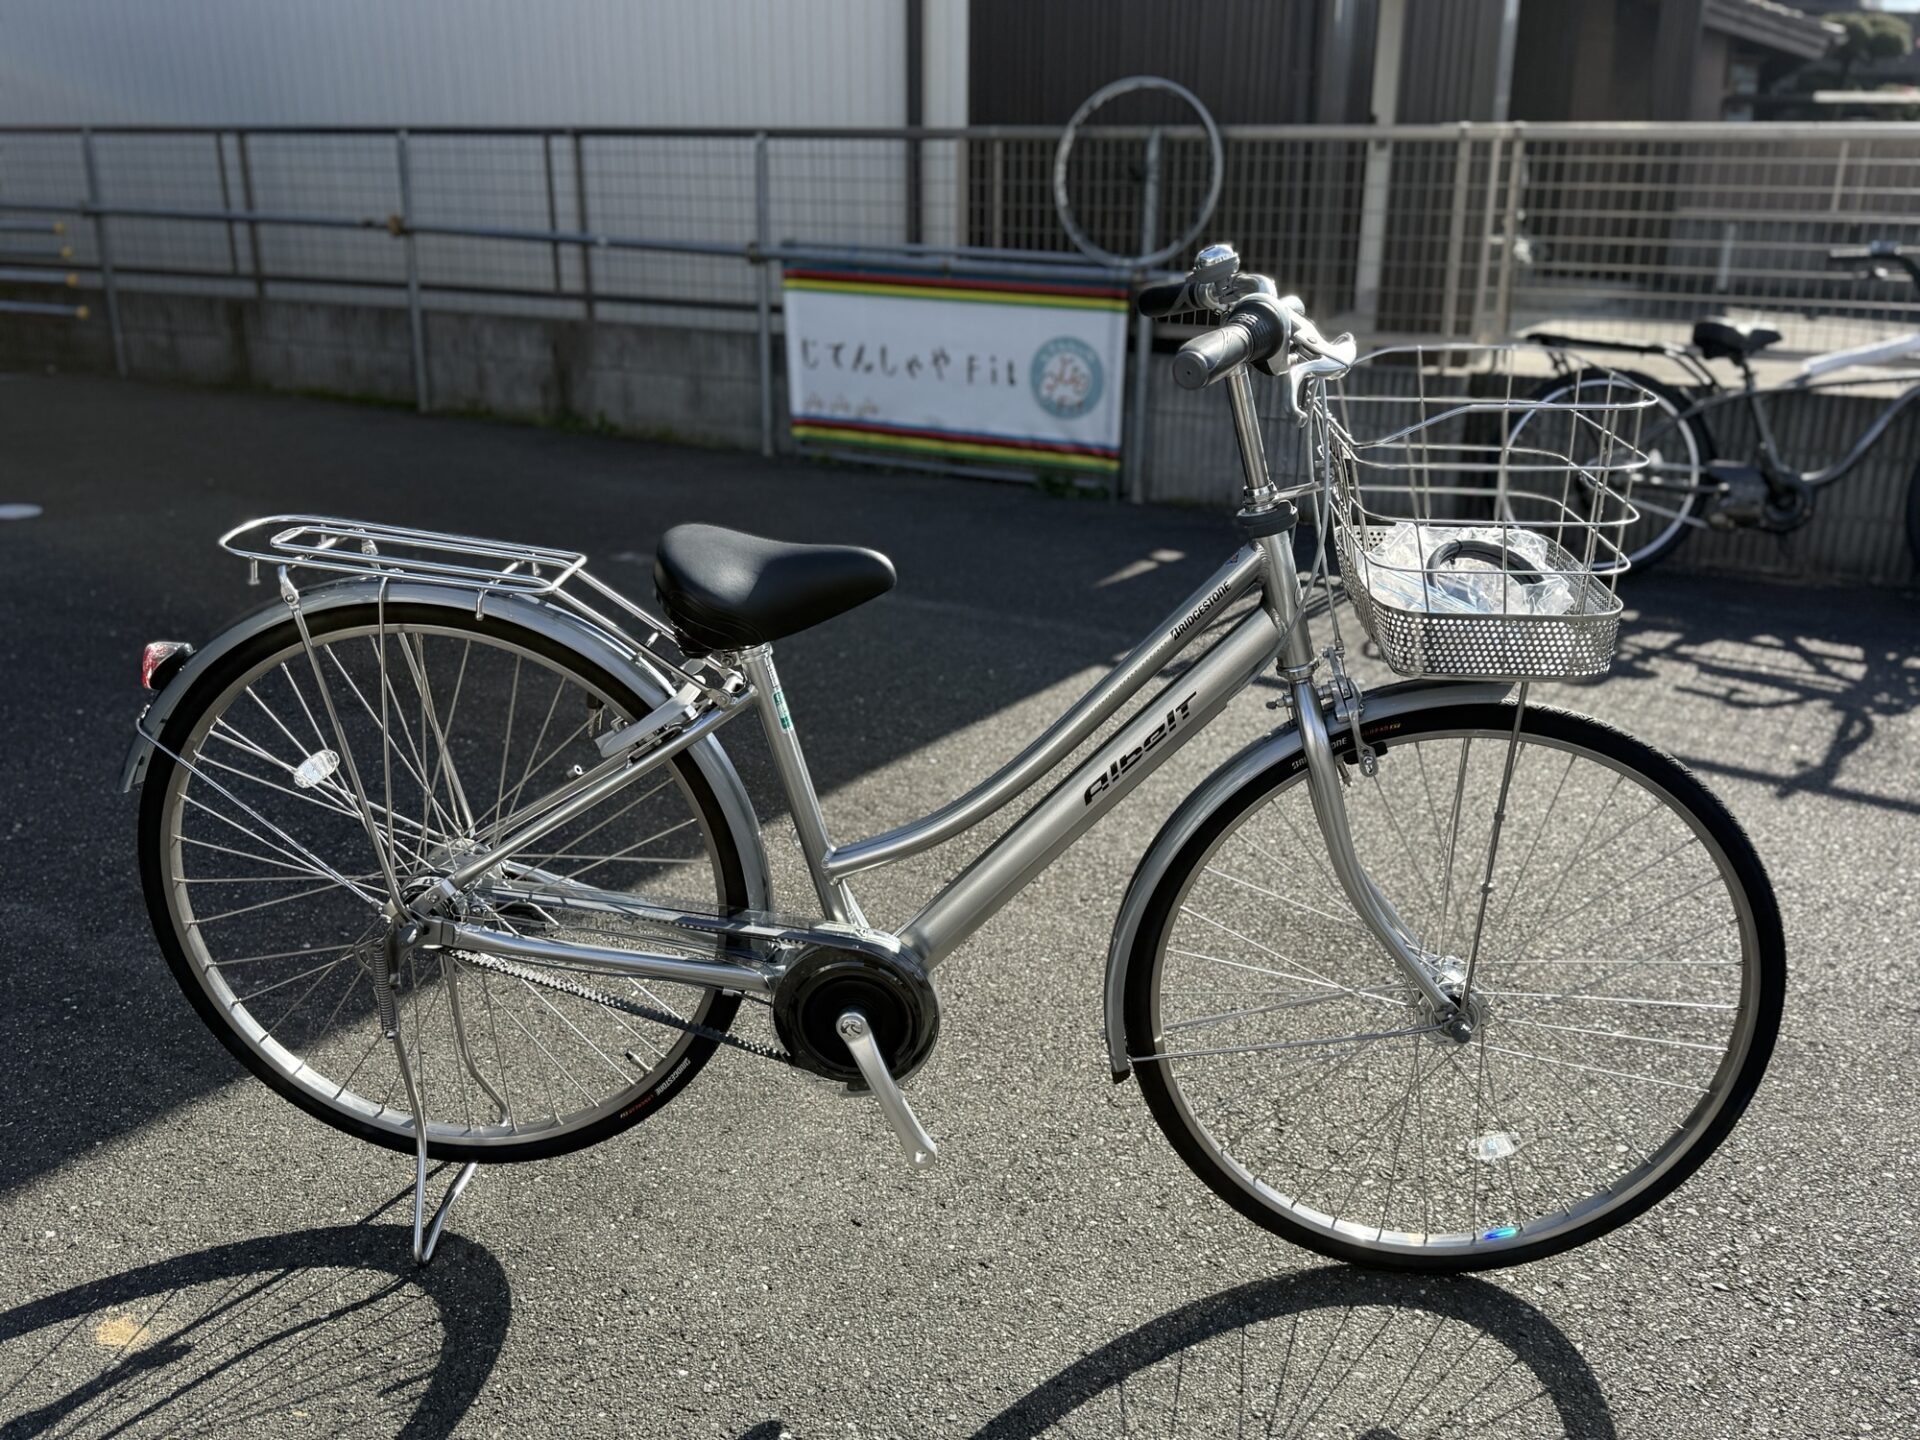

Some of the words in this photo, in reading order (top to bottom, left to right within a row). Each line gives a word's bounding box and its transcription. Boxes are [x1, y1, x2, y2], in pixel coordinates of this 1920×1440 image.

[800, 338, 951, 381] じてんしゃや
[1169, 580, 1232, 641] BRIDGESTONE
